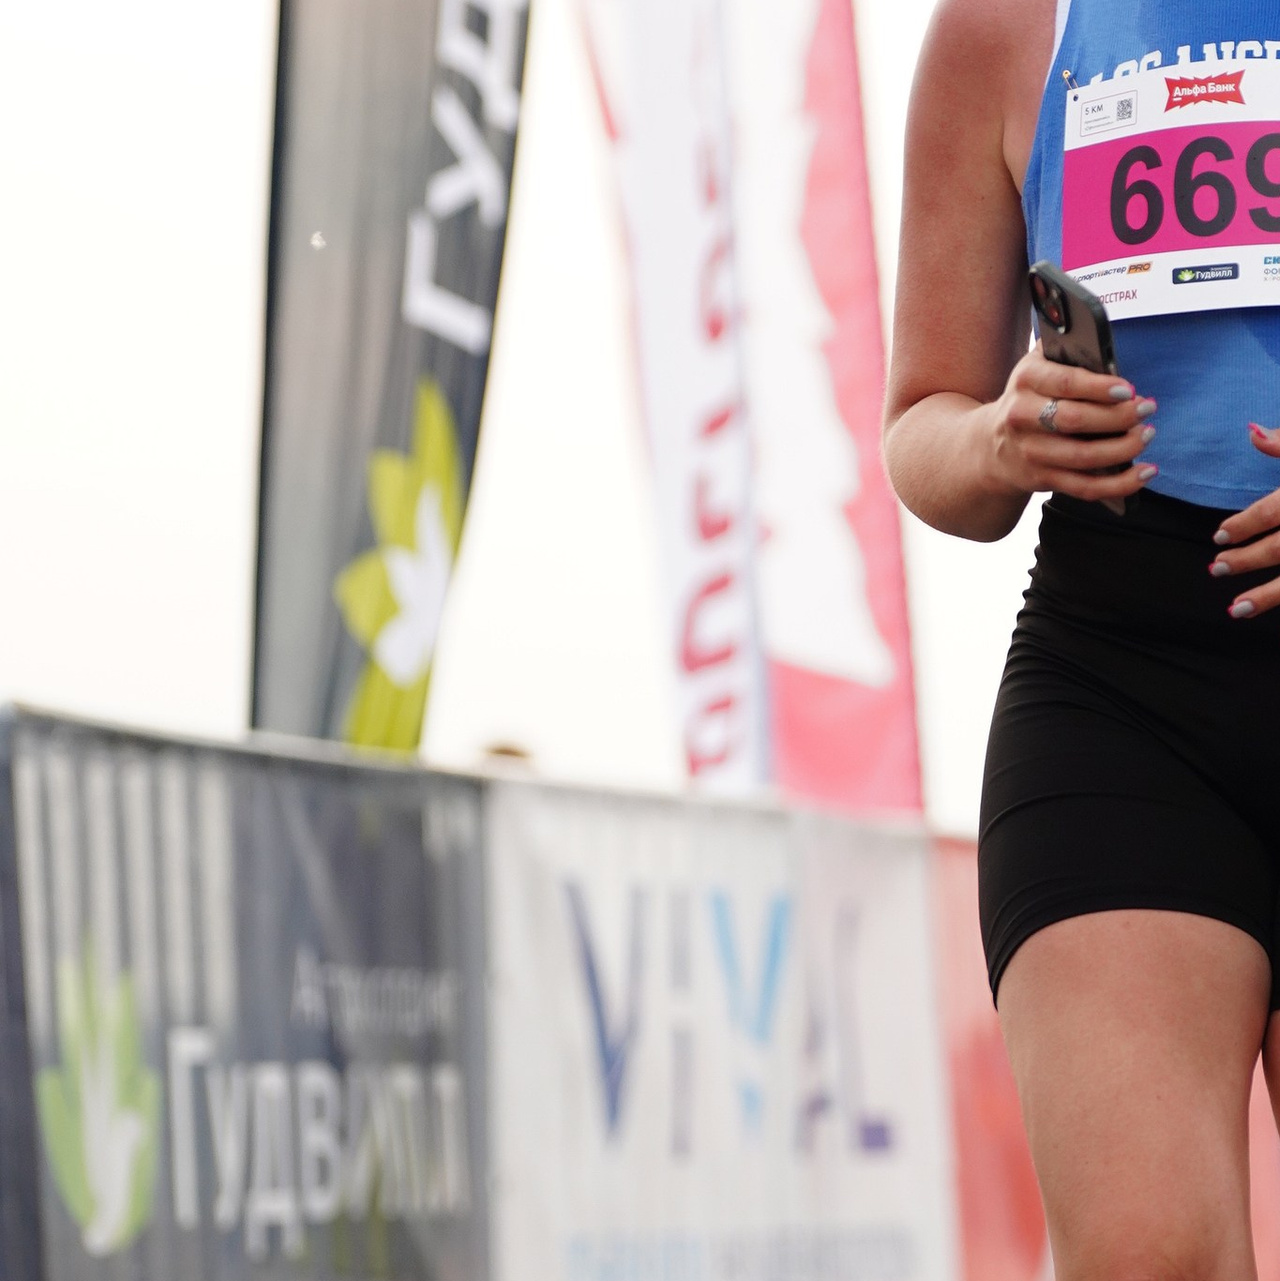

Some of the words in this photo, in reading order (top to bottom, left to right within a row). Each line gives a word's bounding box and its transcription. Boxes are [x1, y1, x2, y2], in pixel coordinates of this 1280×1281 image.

[1173, 84, 1207, 97] Альфа
[1208, 82, 1236, 93] Банк
[1128, 263, 1152, 273] PRO
[1096, 289, 1138, 305] ОССТРАХ
